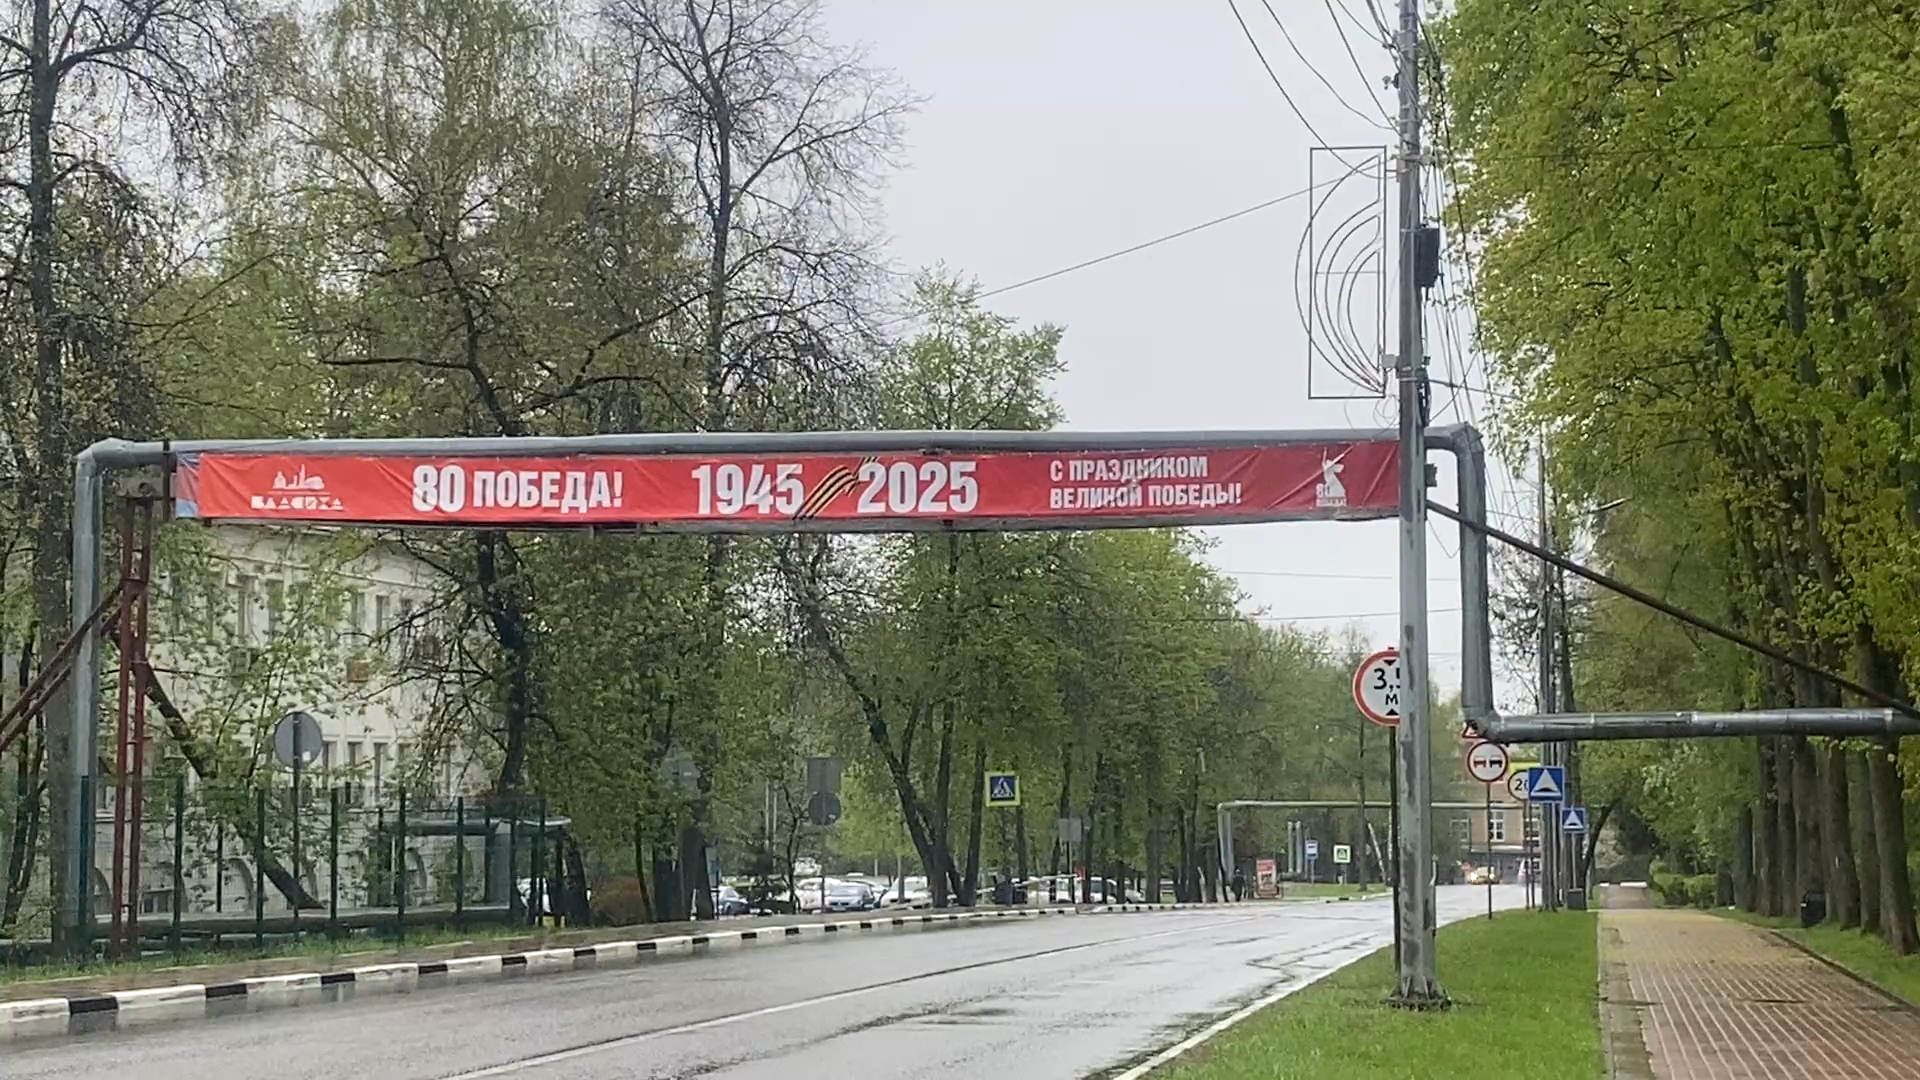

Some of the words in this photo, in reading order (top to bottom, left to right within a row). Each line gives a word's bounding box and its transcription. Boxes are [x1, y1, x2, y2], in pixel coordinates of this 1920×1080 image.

[412, 464, 466, 513] 80
[473, 471, 623, 513] ПОБЕДА!
[692, 463, 805, 514] 1945
[857, 461, 979, 514] 2025
[1050, 460, 1063, 482] С
[1069, 456, 1208, 483] ПРАЗДНИКОМ
[1050, 482, 1142, 509] ВЕЛИКОЙ
[1148, 483, 1241, 508] ПОБЕДЫ!
